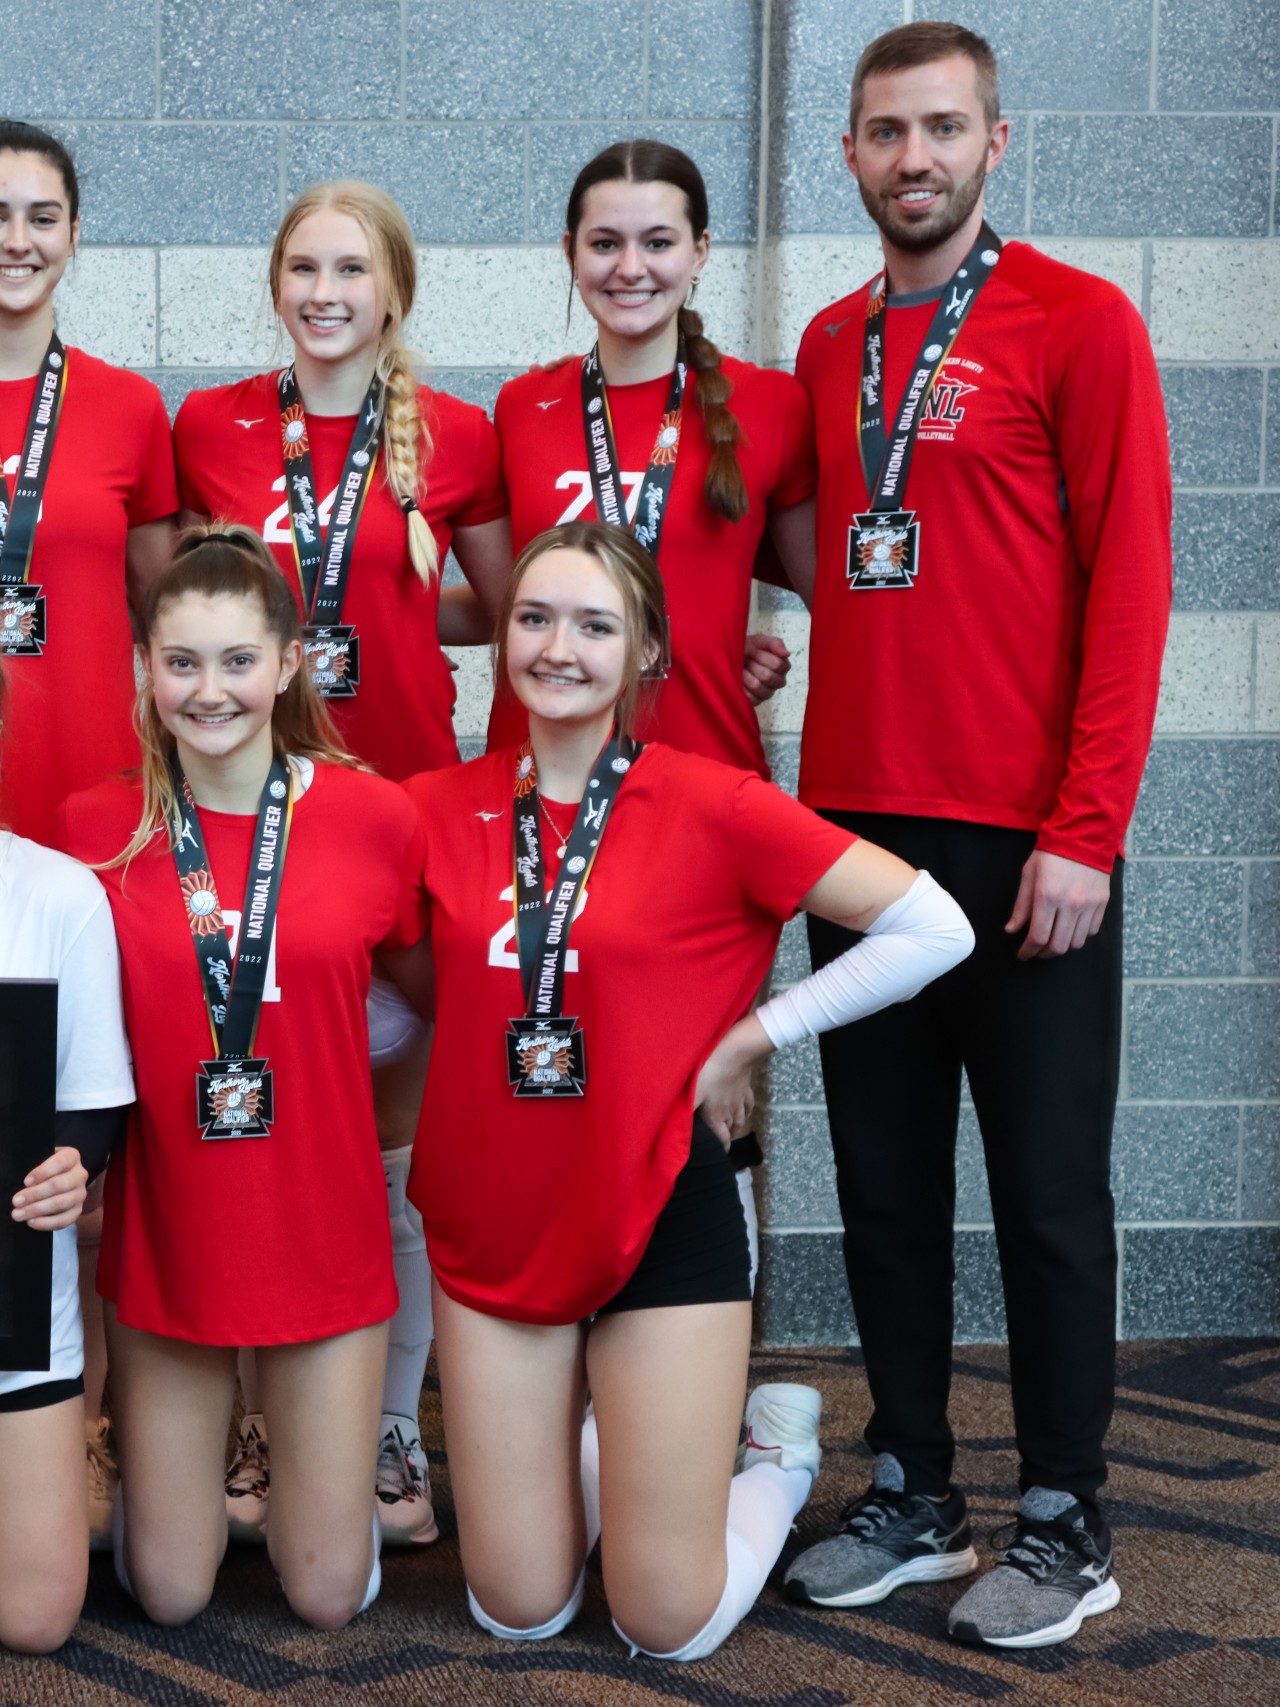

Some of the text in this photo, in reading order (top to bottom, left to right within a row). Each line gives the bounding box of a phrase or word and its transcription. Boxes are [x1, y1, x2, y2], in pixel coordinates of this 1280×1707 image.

[24, 371, 58, 478] NATIONAL QUALIFIER
[881, 435, 908, 496] NATIONAL
[898, 368, 932, 431] QUALIFIER
[920, 384, 965, 422] NL
[590, 418, 612, 474] QUALIFIER
[16, 489, 37, 497] 2022
[293, 474, 316, 543] Northern Lights
[555, 470, 646, 527] 27
[645, 482, 664, 540] Northern
[324, 471, 363, 586] NATIONAL QUALIFIER
[301, 556, 321, 567] 2022
[317, 600, 338, 608] 2022
[247, 806, 282, 939] NATIONAL QUALIFIER
[517, 814, 539, 888] Northern Lights
[519, 901, 540, 912] 2022
[546, 881, 577, 945] QUALIFIER
[239, 955, 262, 963] 2022
[536, 950, 559, 1014] NATIONAL
